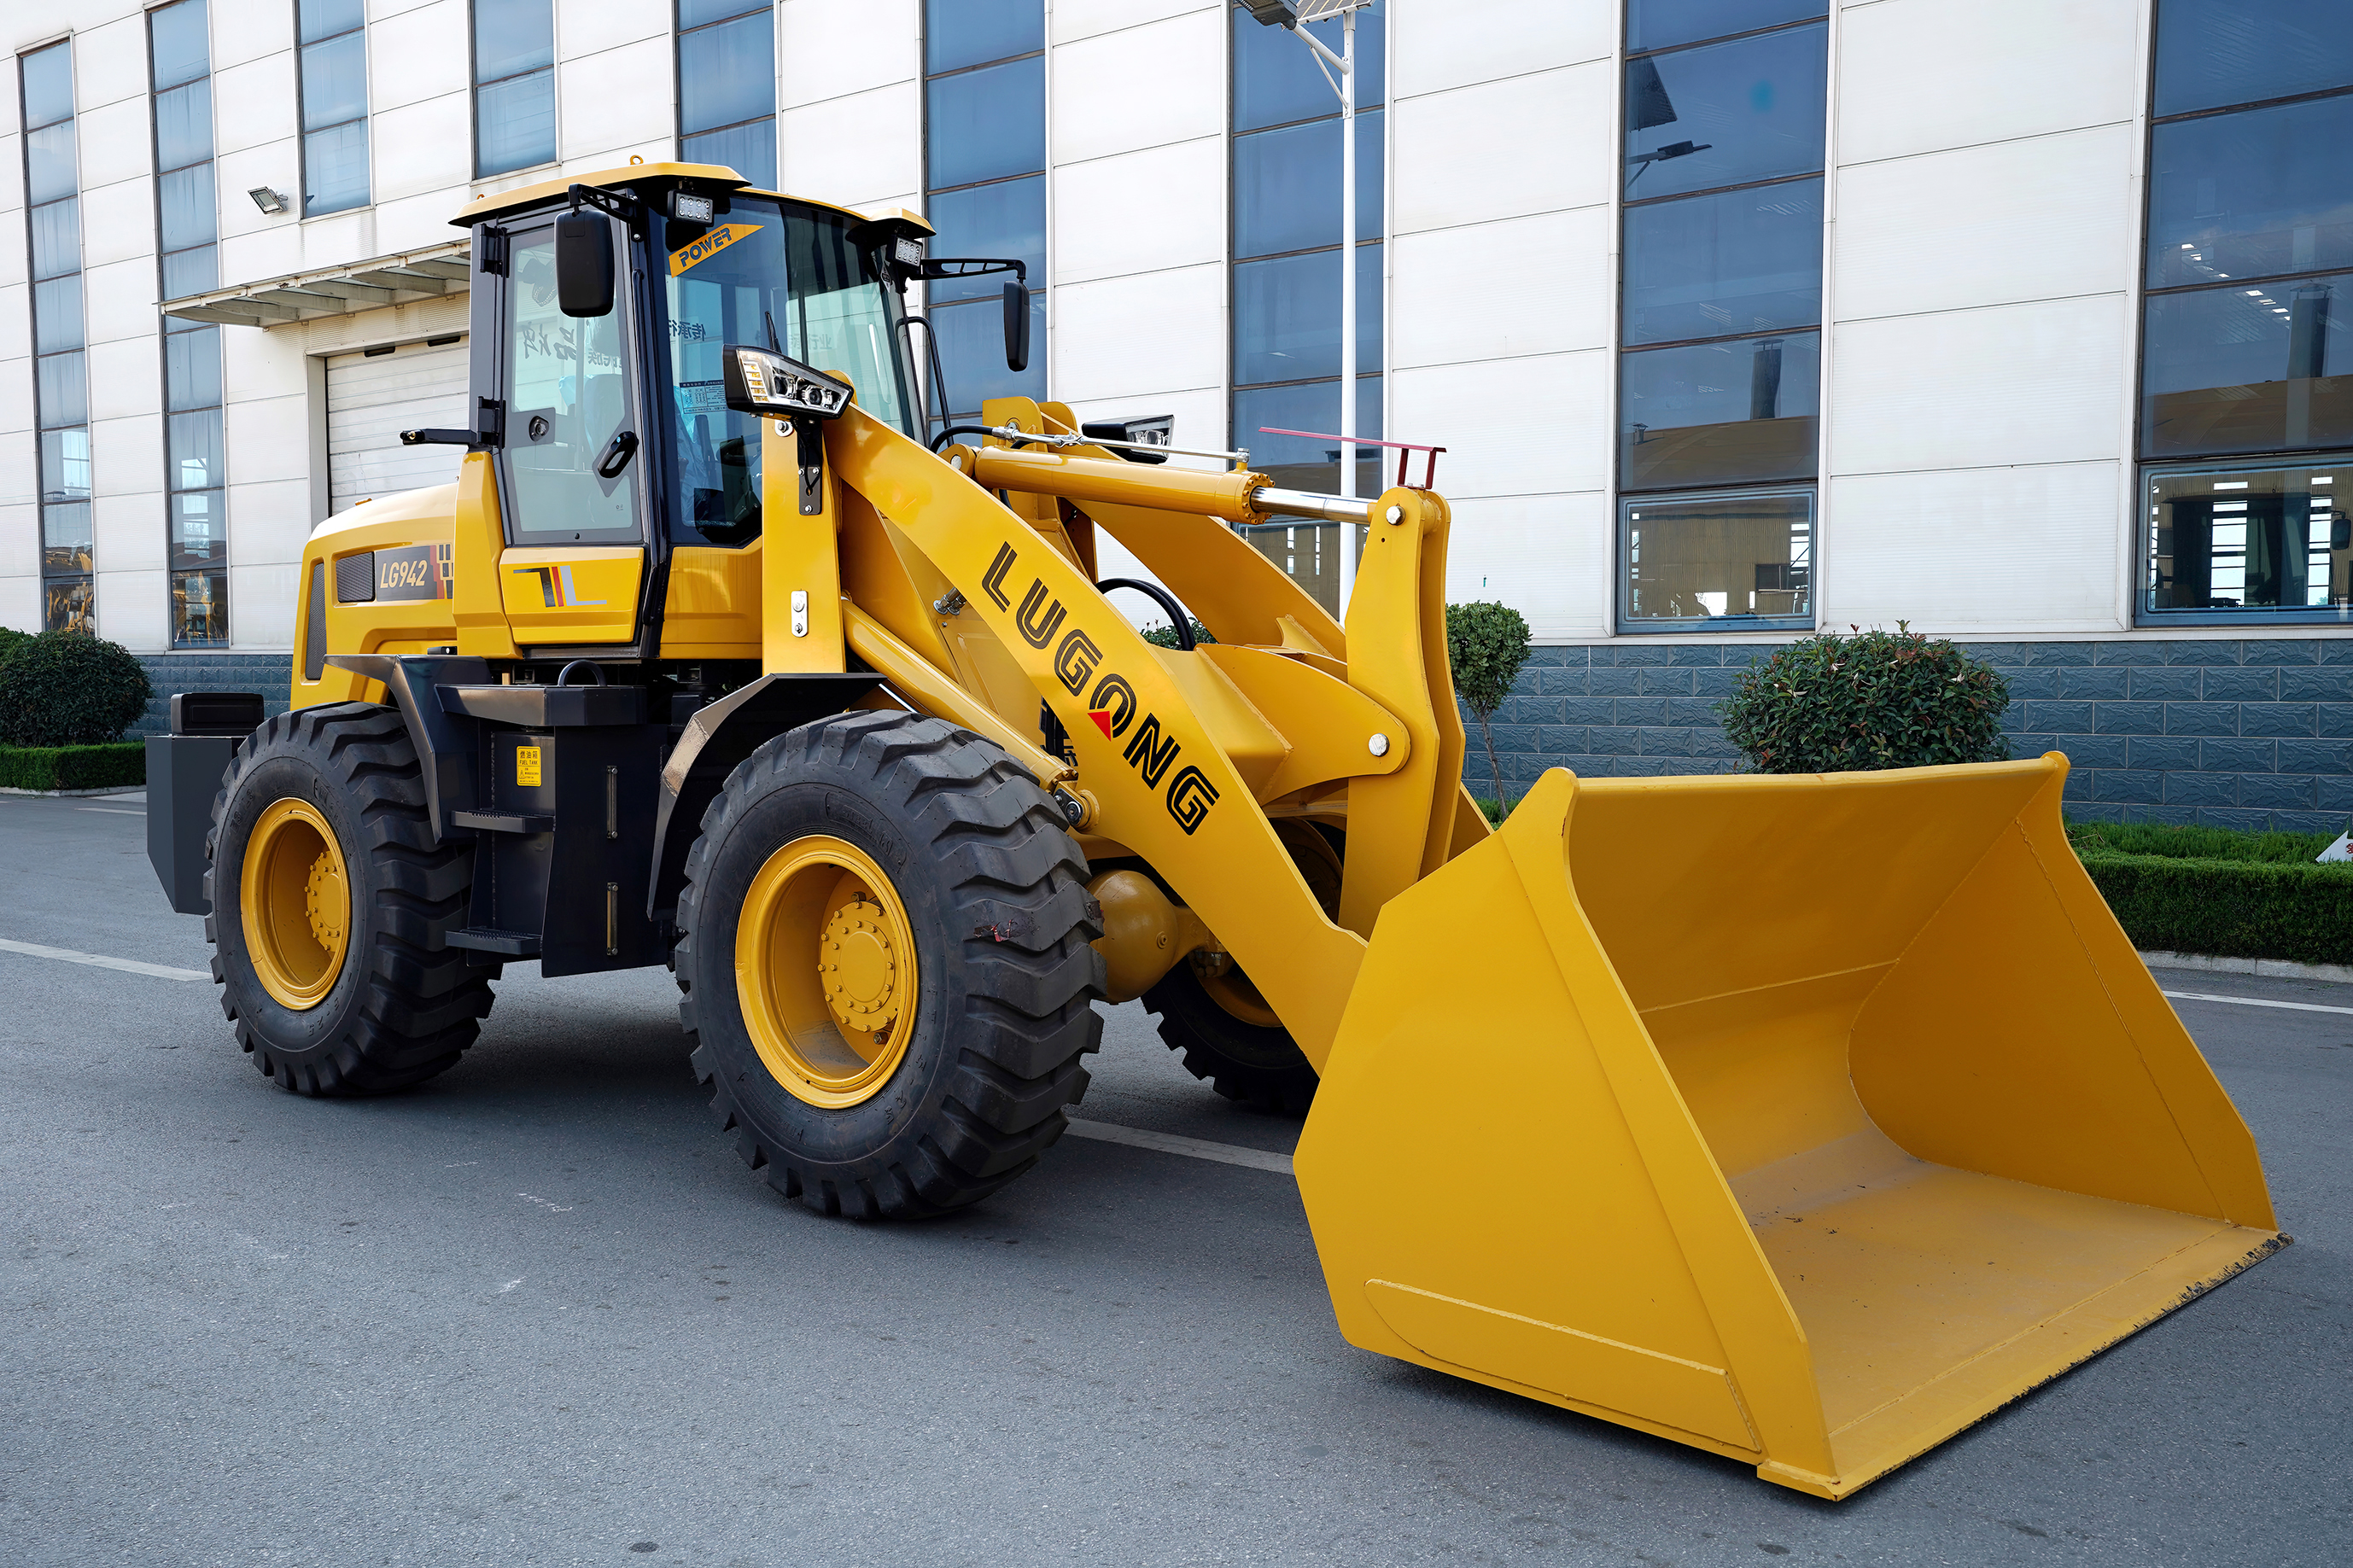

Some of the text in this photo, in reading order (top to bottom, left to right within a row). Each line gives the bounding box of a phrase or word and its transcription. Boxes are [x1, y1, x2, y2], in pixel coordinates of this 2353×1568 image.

[679, 227, 733, 268] POWER
[380, 559, 428, 589] LG942
[981, 540, 1221, 836] LUGONG
